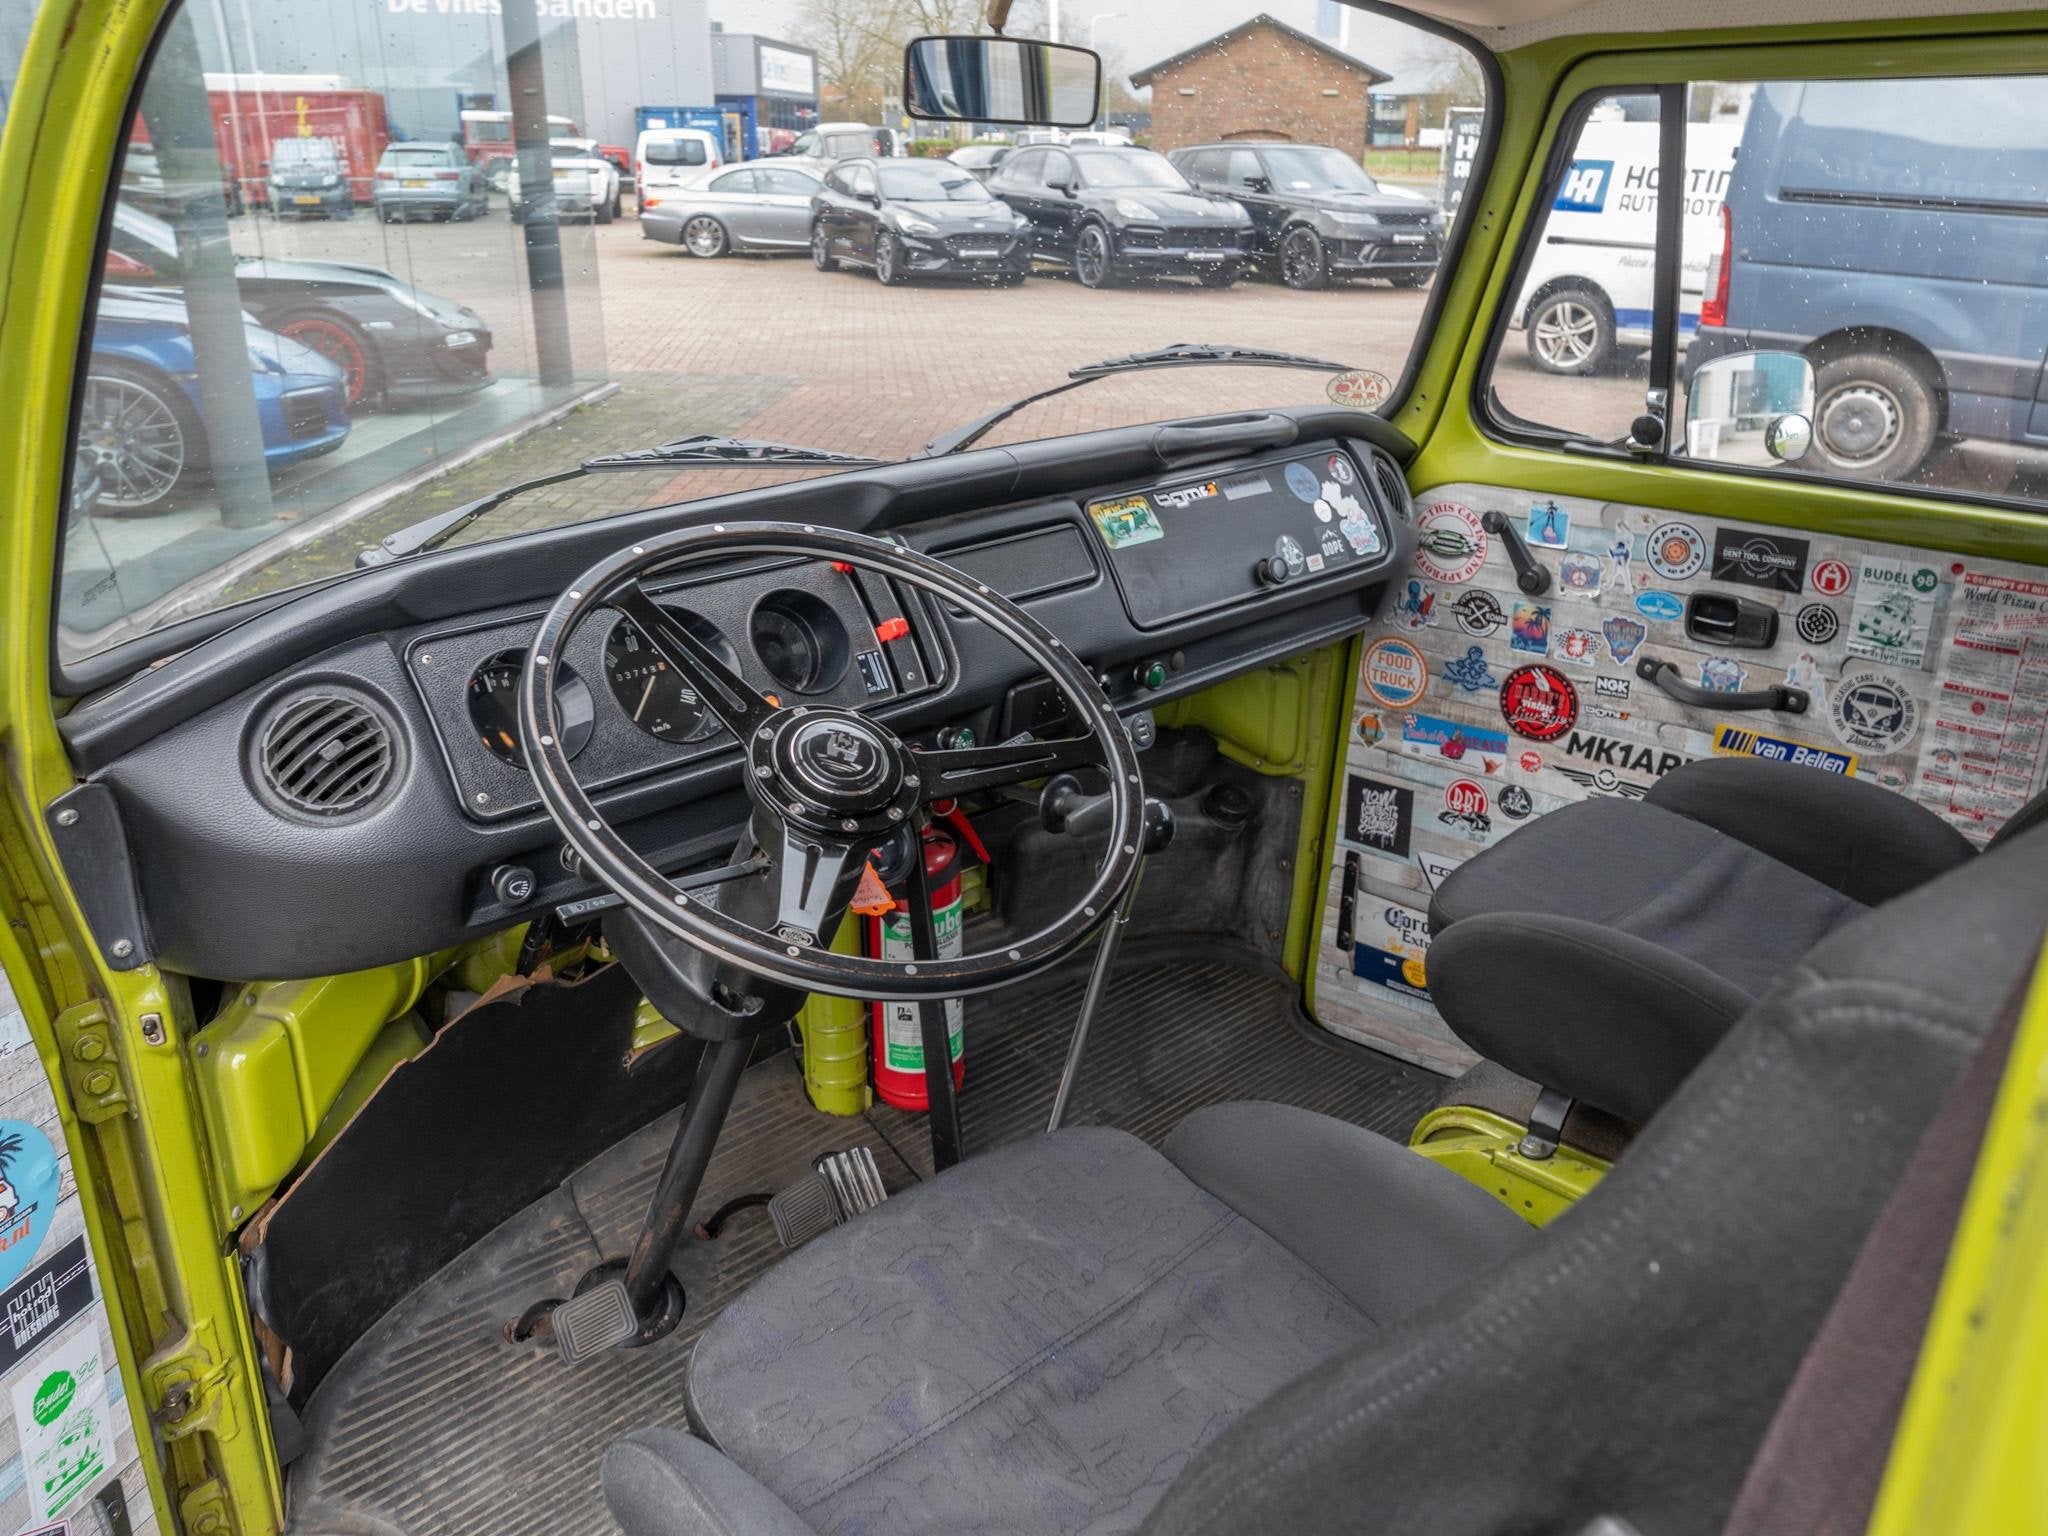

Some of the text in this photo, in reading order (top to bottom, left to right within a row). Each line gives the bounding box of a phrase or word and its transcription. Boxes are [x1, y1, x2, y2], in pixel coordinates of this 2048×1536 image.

[1427, 503, 1455, 517] THIS
[1458, 506, 1479, 527] CAR
[1415, 547, 1462, 581] APPROVE
[1723, 548, 1742, 559] DENT
[1762, 555, 1796, 567] COMPANY
[1864, 568, 1909, 585] BUDEL
[1917, 574, 1934, 588] 98
[1964, 587, 2036, 610] World Pizza
[1378, 653, 1412, 670] FOOD
[1372, 668, 1416, 689] TRUCK
[1597, 678, 1628, 693] NGK
[1856, 673, 1874, 682] CARS
[680, 688, 697, 705] 140
[1755, 741, 1845, 774] van Bellen
[1451, 786, 1482, 814] BBT
[13, 1286, 51, 1323] hot rod
